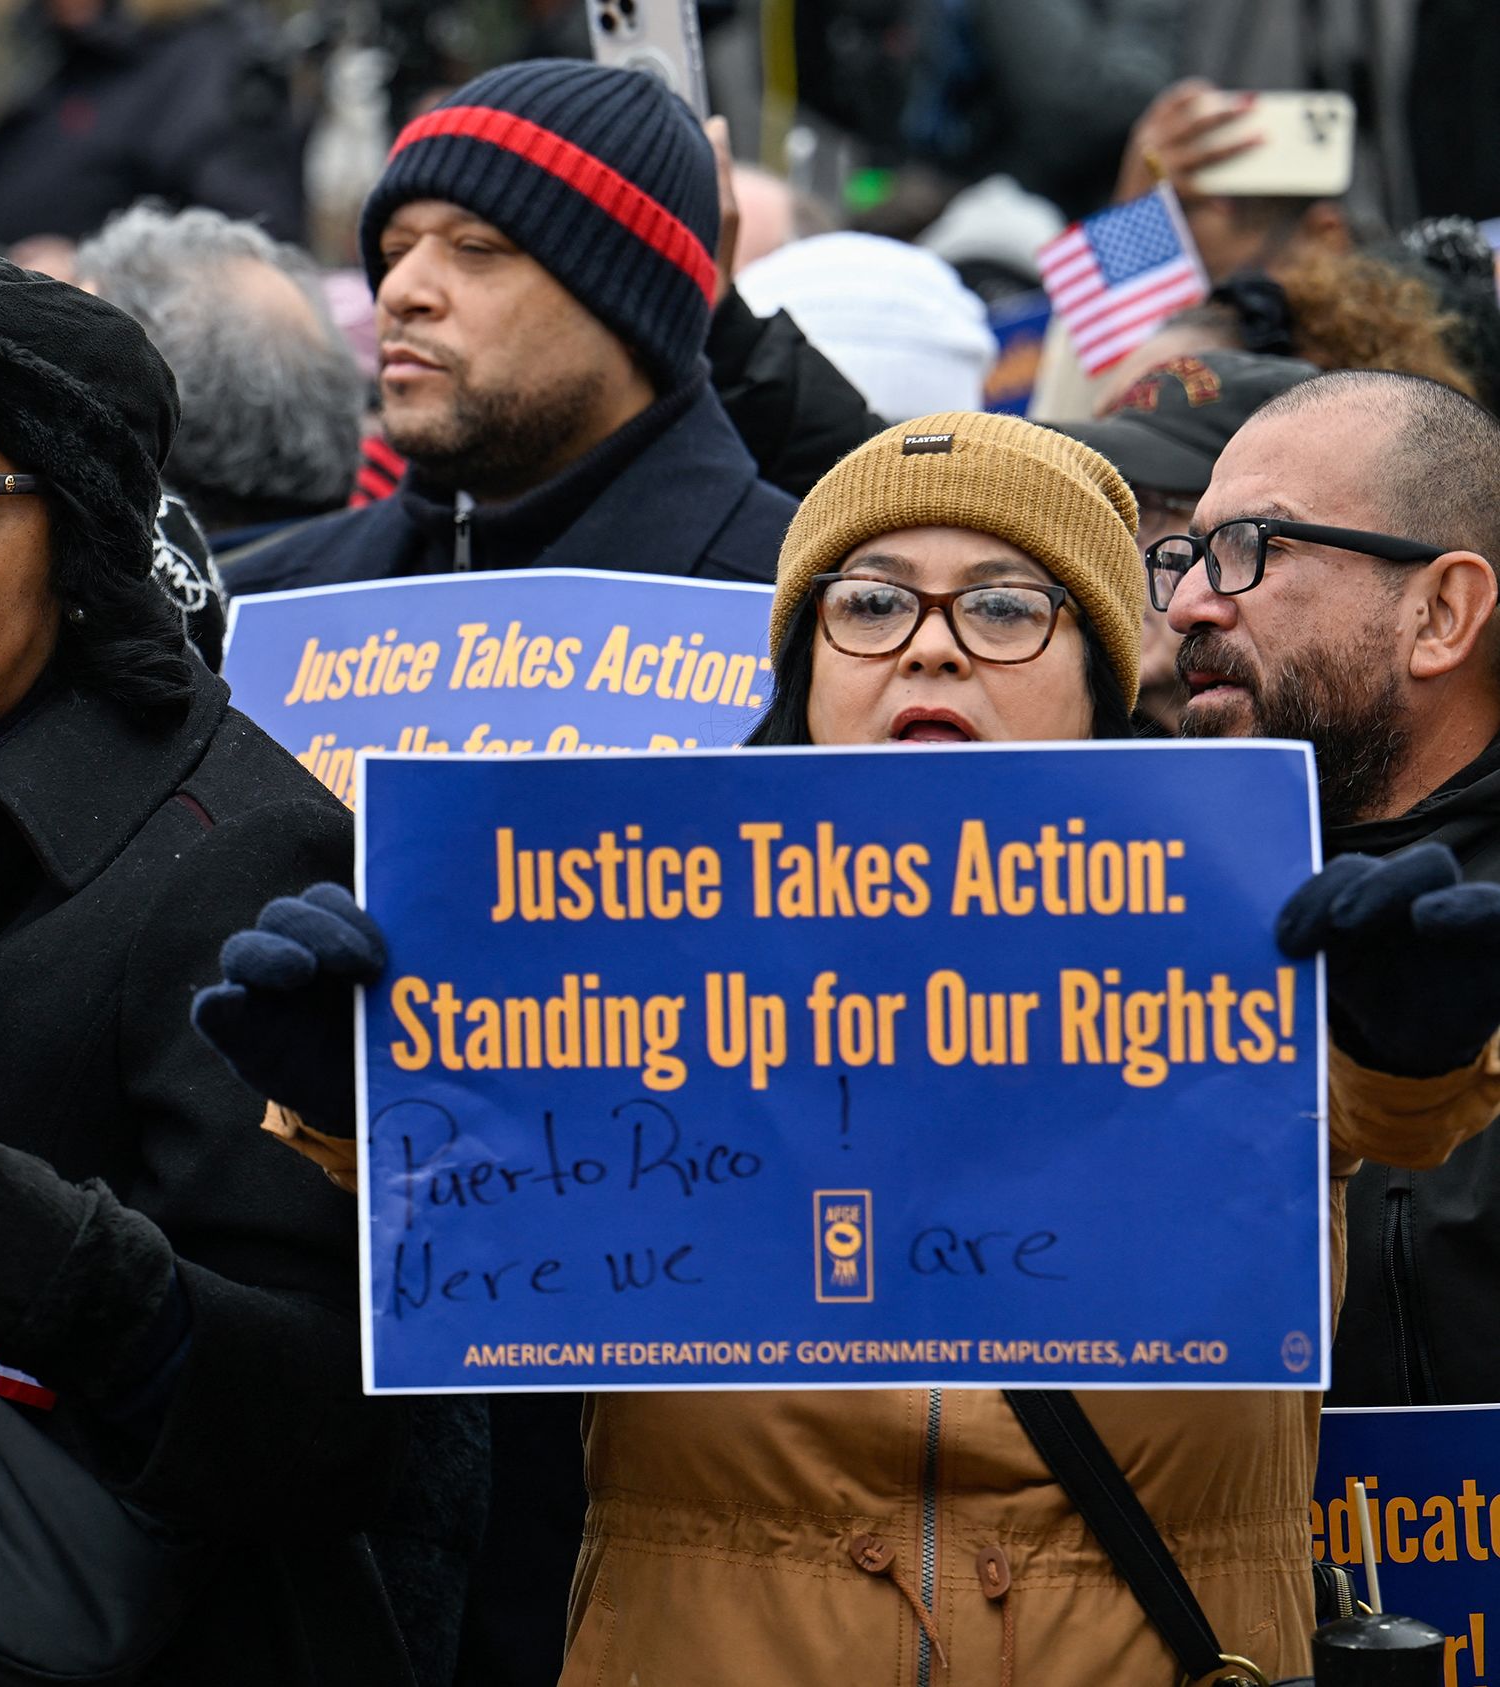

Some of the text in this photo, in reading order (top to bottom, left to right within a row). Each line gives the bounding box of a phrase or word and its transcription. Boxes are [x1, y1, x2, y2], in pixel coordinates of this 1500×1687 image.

[904, 435, 951, 445] PLAYBOY
[285, 620, 772, 709] Justice Takes Action:
[492, 819, 1185, 922] Justice Takes Action:
[391, 967, 1296, 1091] Standing Up for Our Rights!
[368, 1098, 607, 1230] Puerto
[611, 1098, 763, 1197] Rico
[605, 1244, 704, 1294] we
[908, 1224, 1069, 1282] are
[464, 1340, 1229, 1368] AMERICAN FEDERATION OF GOVERNMENT EMPLOYEES, AFL-CIO
